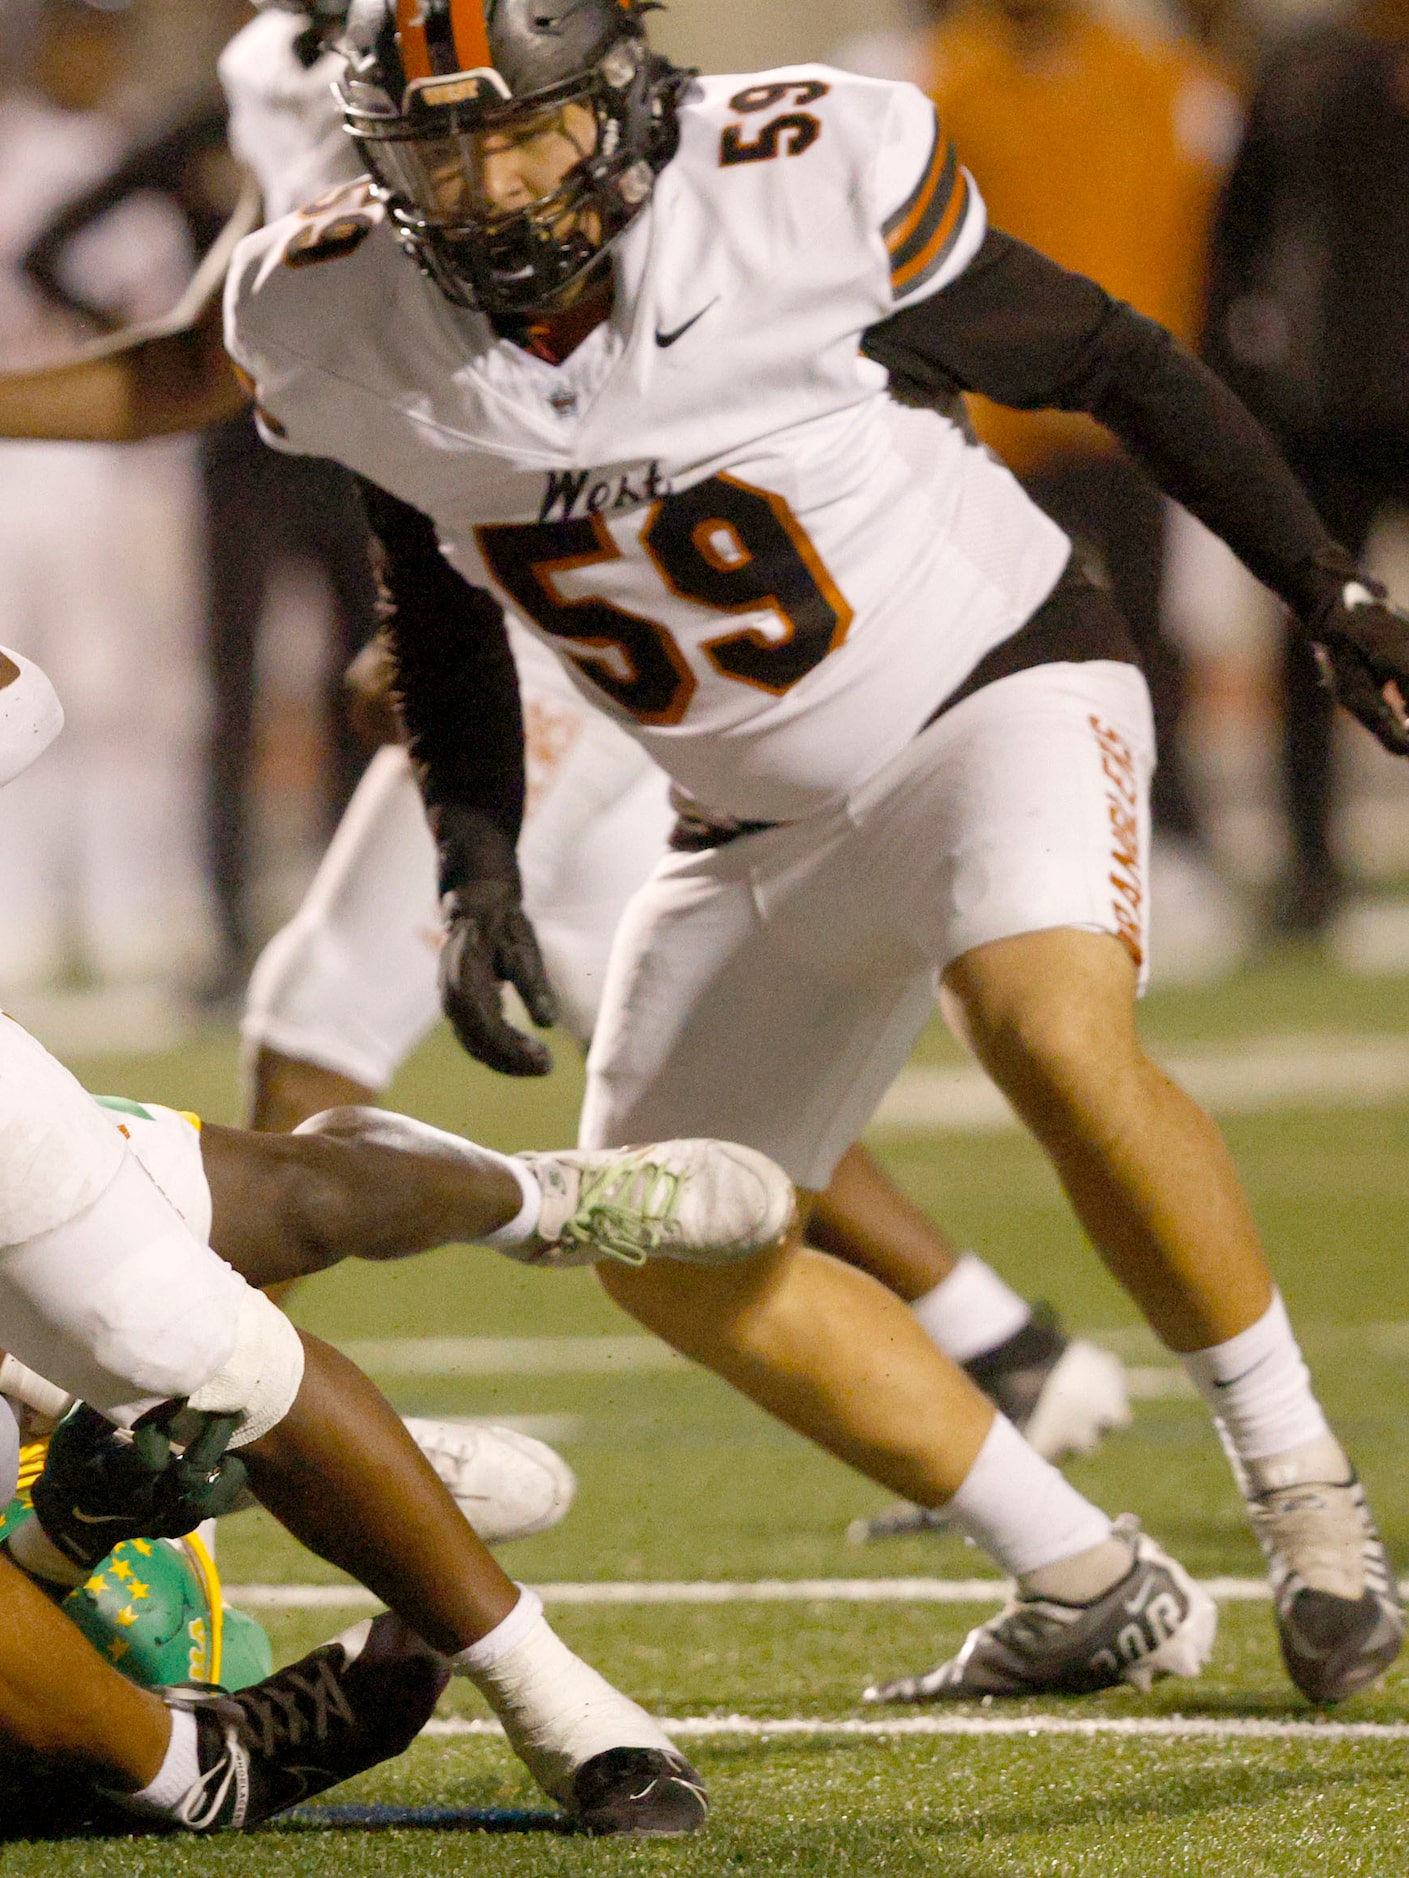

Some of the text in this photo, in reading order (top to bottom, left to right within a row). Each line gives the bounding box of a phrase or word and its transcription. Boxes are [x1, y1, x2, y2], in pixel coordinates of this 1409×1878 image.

[719, 80, 830, 168] 59
[538, 459, 672, 524] West
[472, 470, 854, 725] 59
